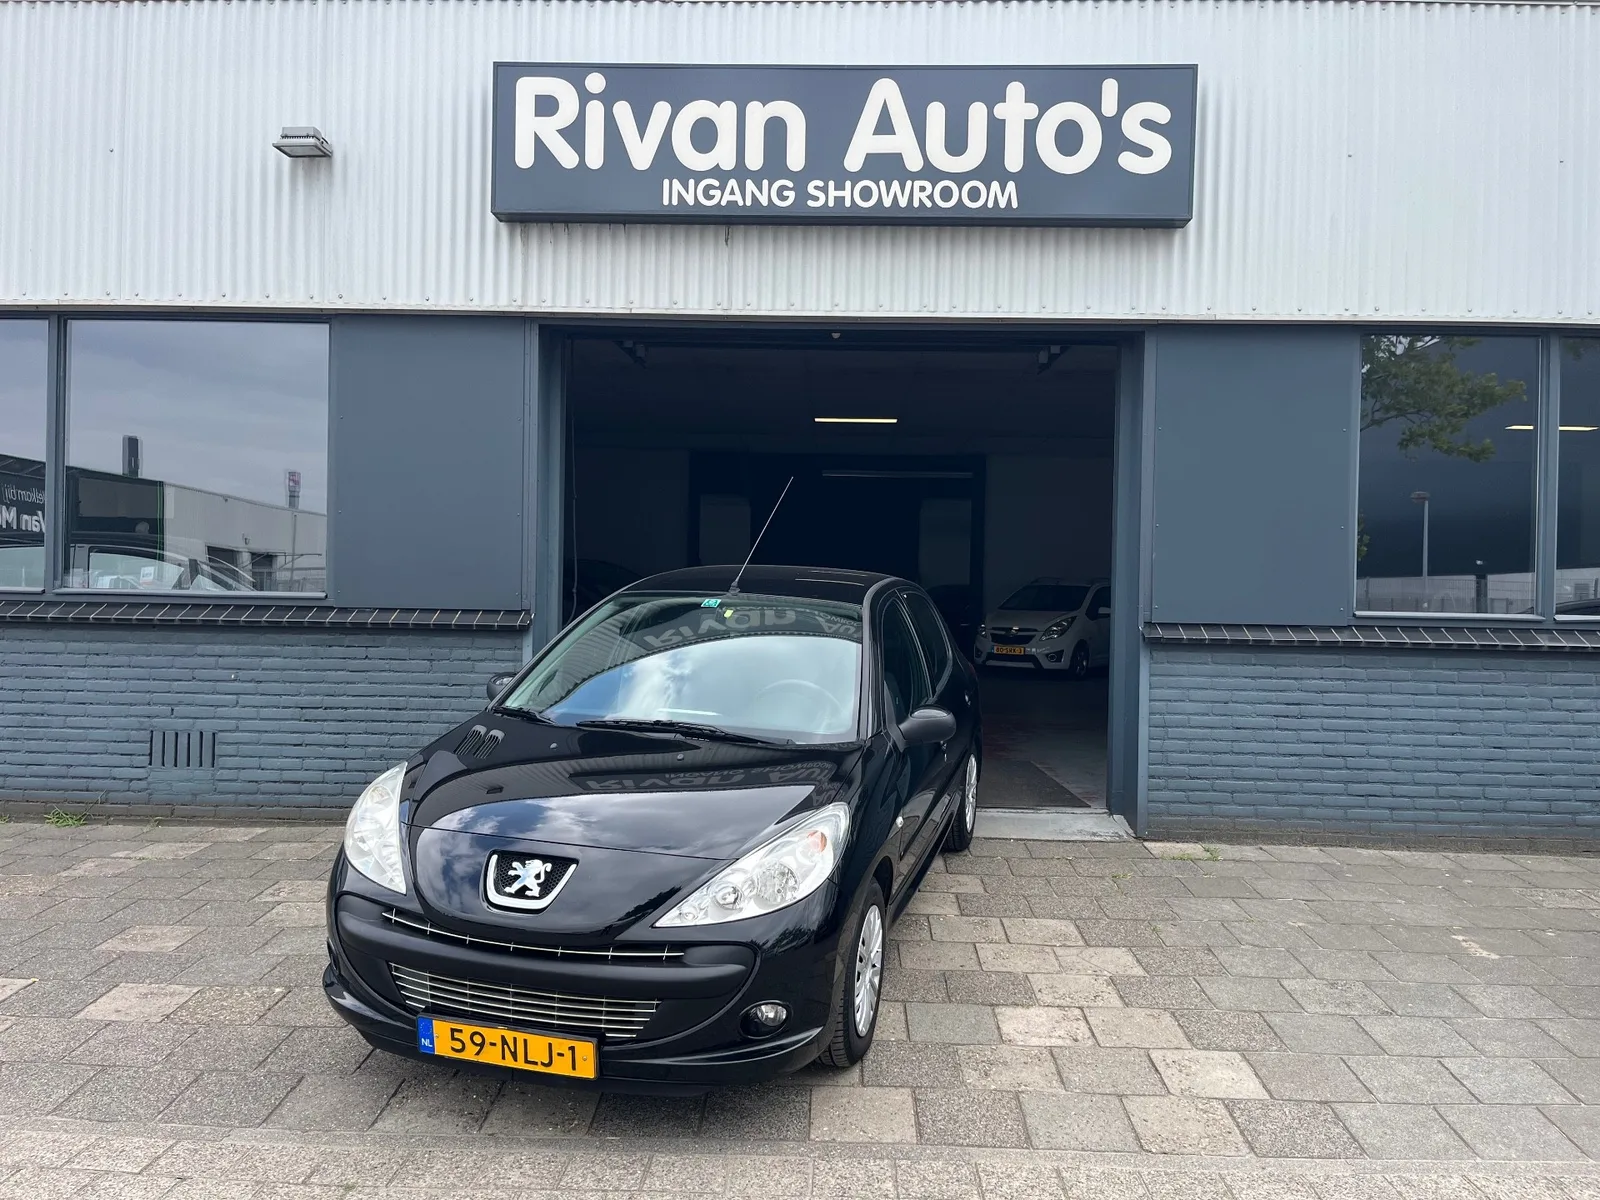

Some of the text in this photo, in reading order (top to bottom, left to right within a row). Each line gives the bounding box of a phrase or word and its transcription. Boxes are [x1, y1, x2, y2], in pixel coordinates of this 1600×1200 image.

[514, 72, 1172, 175] Rivan Auto's
[662, 178, 1018, 209] INGANG SHOWROOM
[421, 1027, 577, 1071] NL 59-NLJ-1
